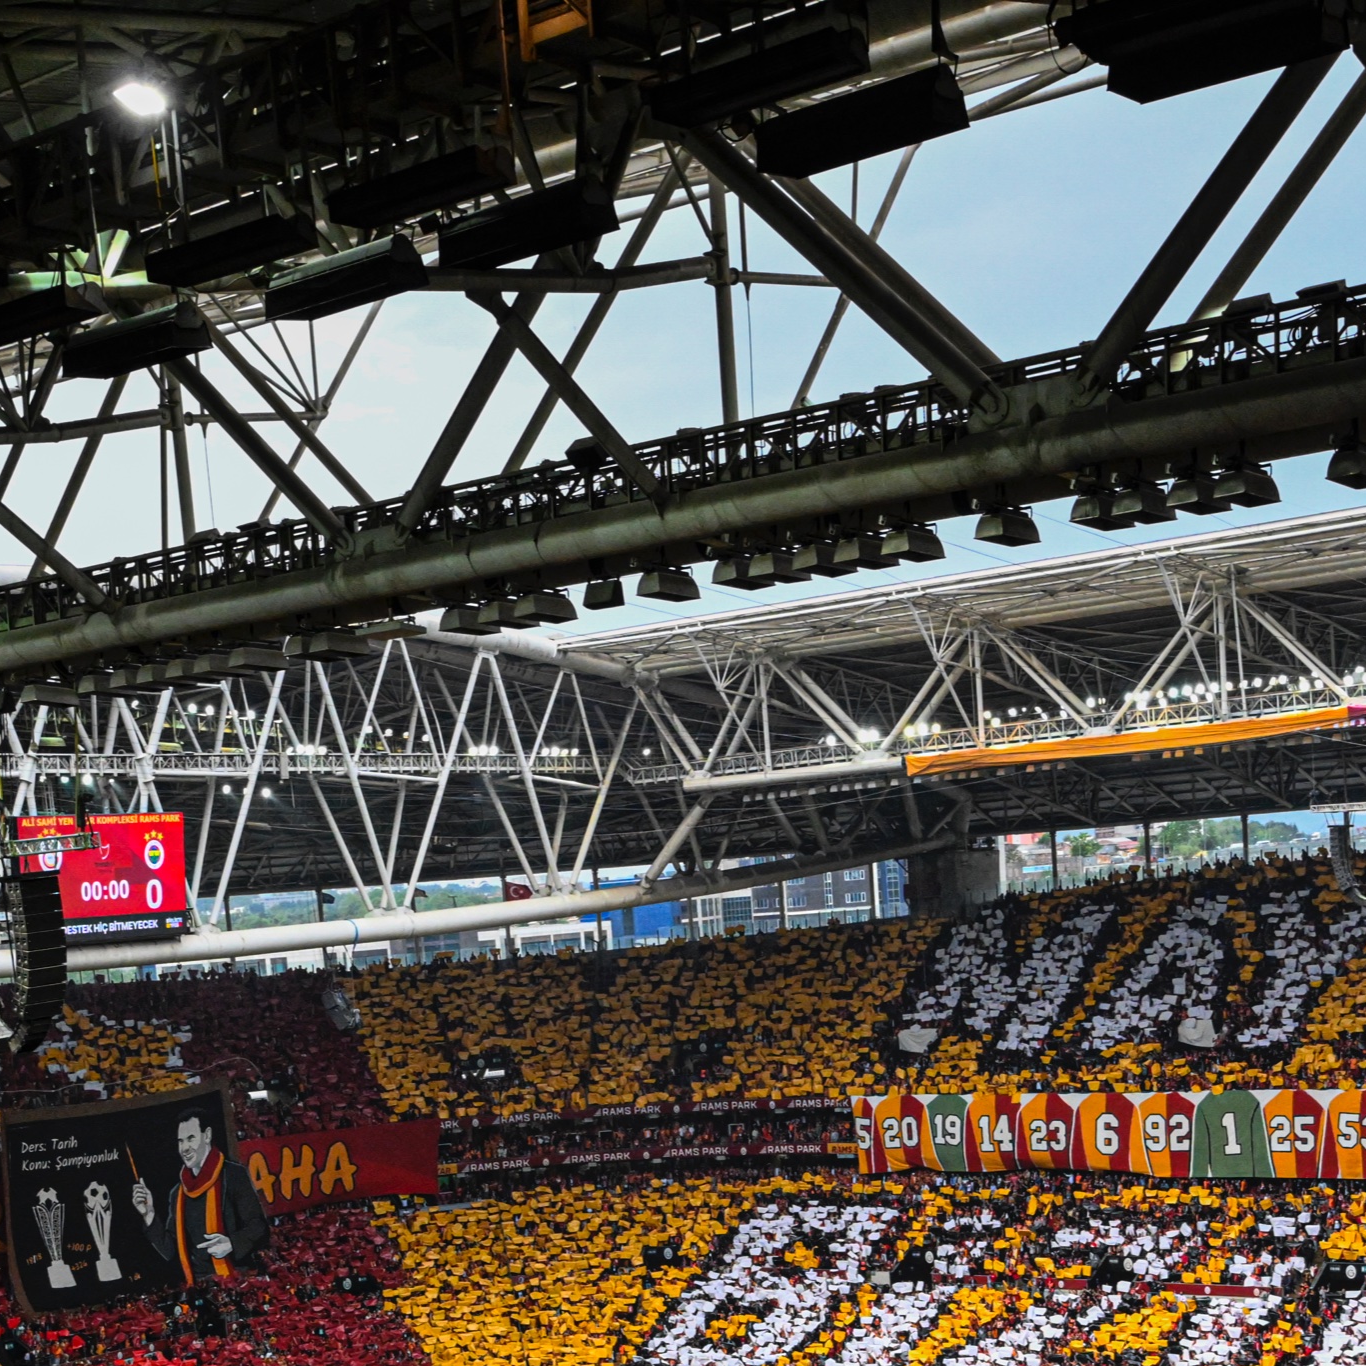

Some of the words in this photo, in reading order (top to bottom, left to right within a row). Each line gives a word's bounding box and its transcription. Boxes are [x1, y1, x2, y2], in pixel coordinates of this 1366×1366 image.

[21, 816, 35, 827] ALİ
[36, 815, 57, 827] SAMİ
[58, 816, 74, 826] YEN
[96, 813, 138, 825] KOMPLEKSİ
[140, 815, 160, 823] RAMS
[161, 814, 180, 823] PARK
[81, 880, 130, 901] 00:00
[146, 879, 163, 909] 0
[93, 921, 109, 934] HİÇ
[109, 919, 159, 932] BİTMEYECEK
[602, 1106, 632, 1116] RAMS
[634, 1104, 661, 1114] PARK
[700, 1101, 730, 1111] RAMS
[731, 1100, 758, 1110] PARK
[795, 1099, 823, 1108] RAMS
[824, 1098, 850, 1108] PARK
[501, 1114, 531, 1124] RAMS
[533, 1111, 561, 1122] PARK
[882, 1115, 919, 1149] 20
[933, 1113, 963, 1146] 19
[977, 1114, 1014, 1152] 14
[1029, 1118, 1067, 1152] 23
[1094, 1112, 1119, 1155] 6
[1143, 1113, 1191, 1152] 92
[1221, 1111, 1242, 1156] 1
[1268, 1114, 1316, 1153] 25
[21, 1141, 47, 1154] Ders:
[51, 1135, 78, 1150] Tarih
[671, 1148, 701, 1157] RAMS
[702, 1146, 730, 1156] PARK
[767, 1145, 796, 1154] RAMS
[796, 1144, 822, 1154] PARK
[21, 1158, 51, 1172] Konu:
[55, 1148, 120, 1171] Şampiyonluk
[470, 1161, 501, 1172] RAMS
[502, 1159, 531, 1169] PARK
[571, 1154, 602, 1164] RAMS
[603, 1152, 632, 1162] PARK
